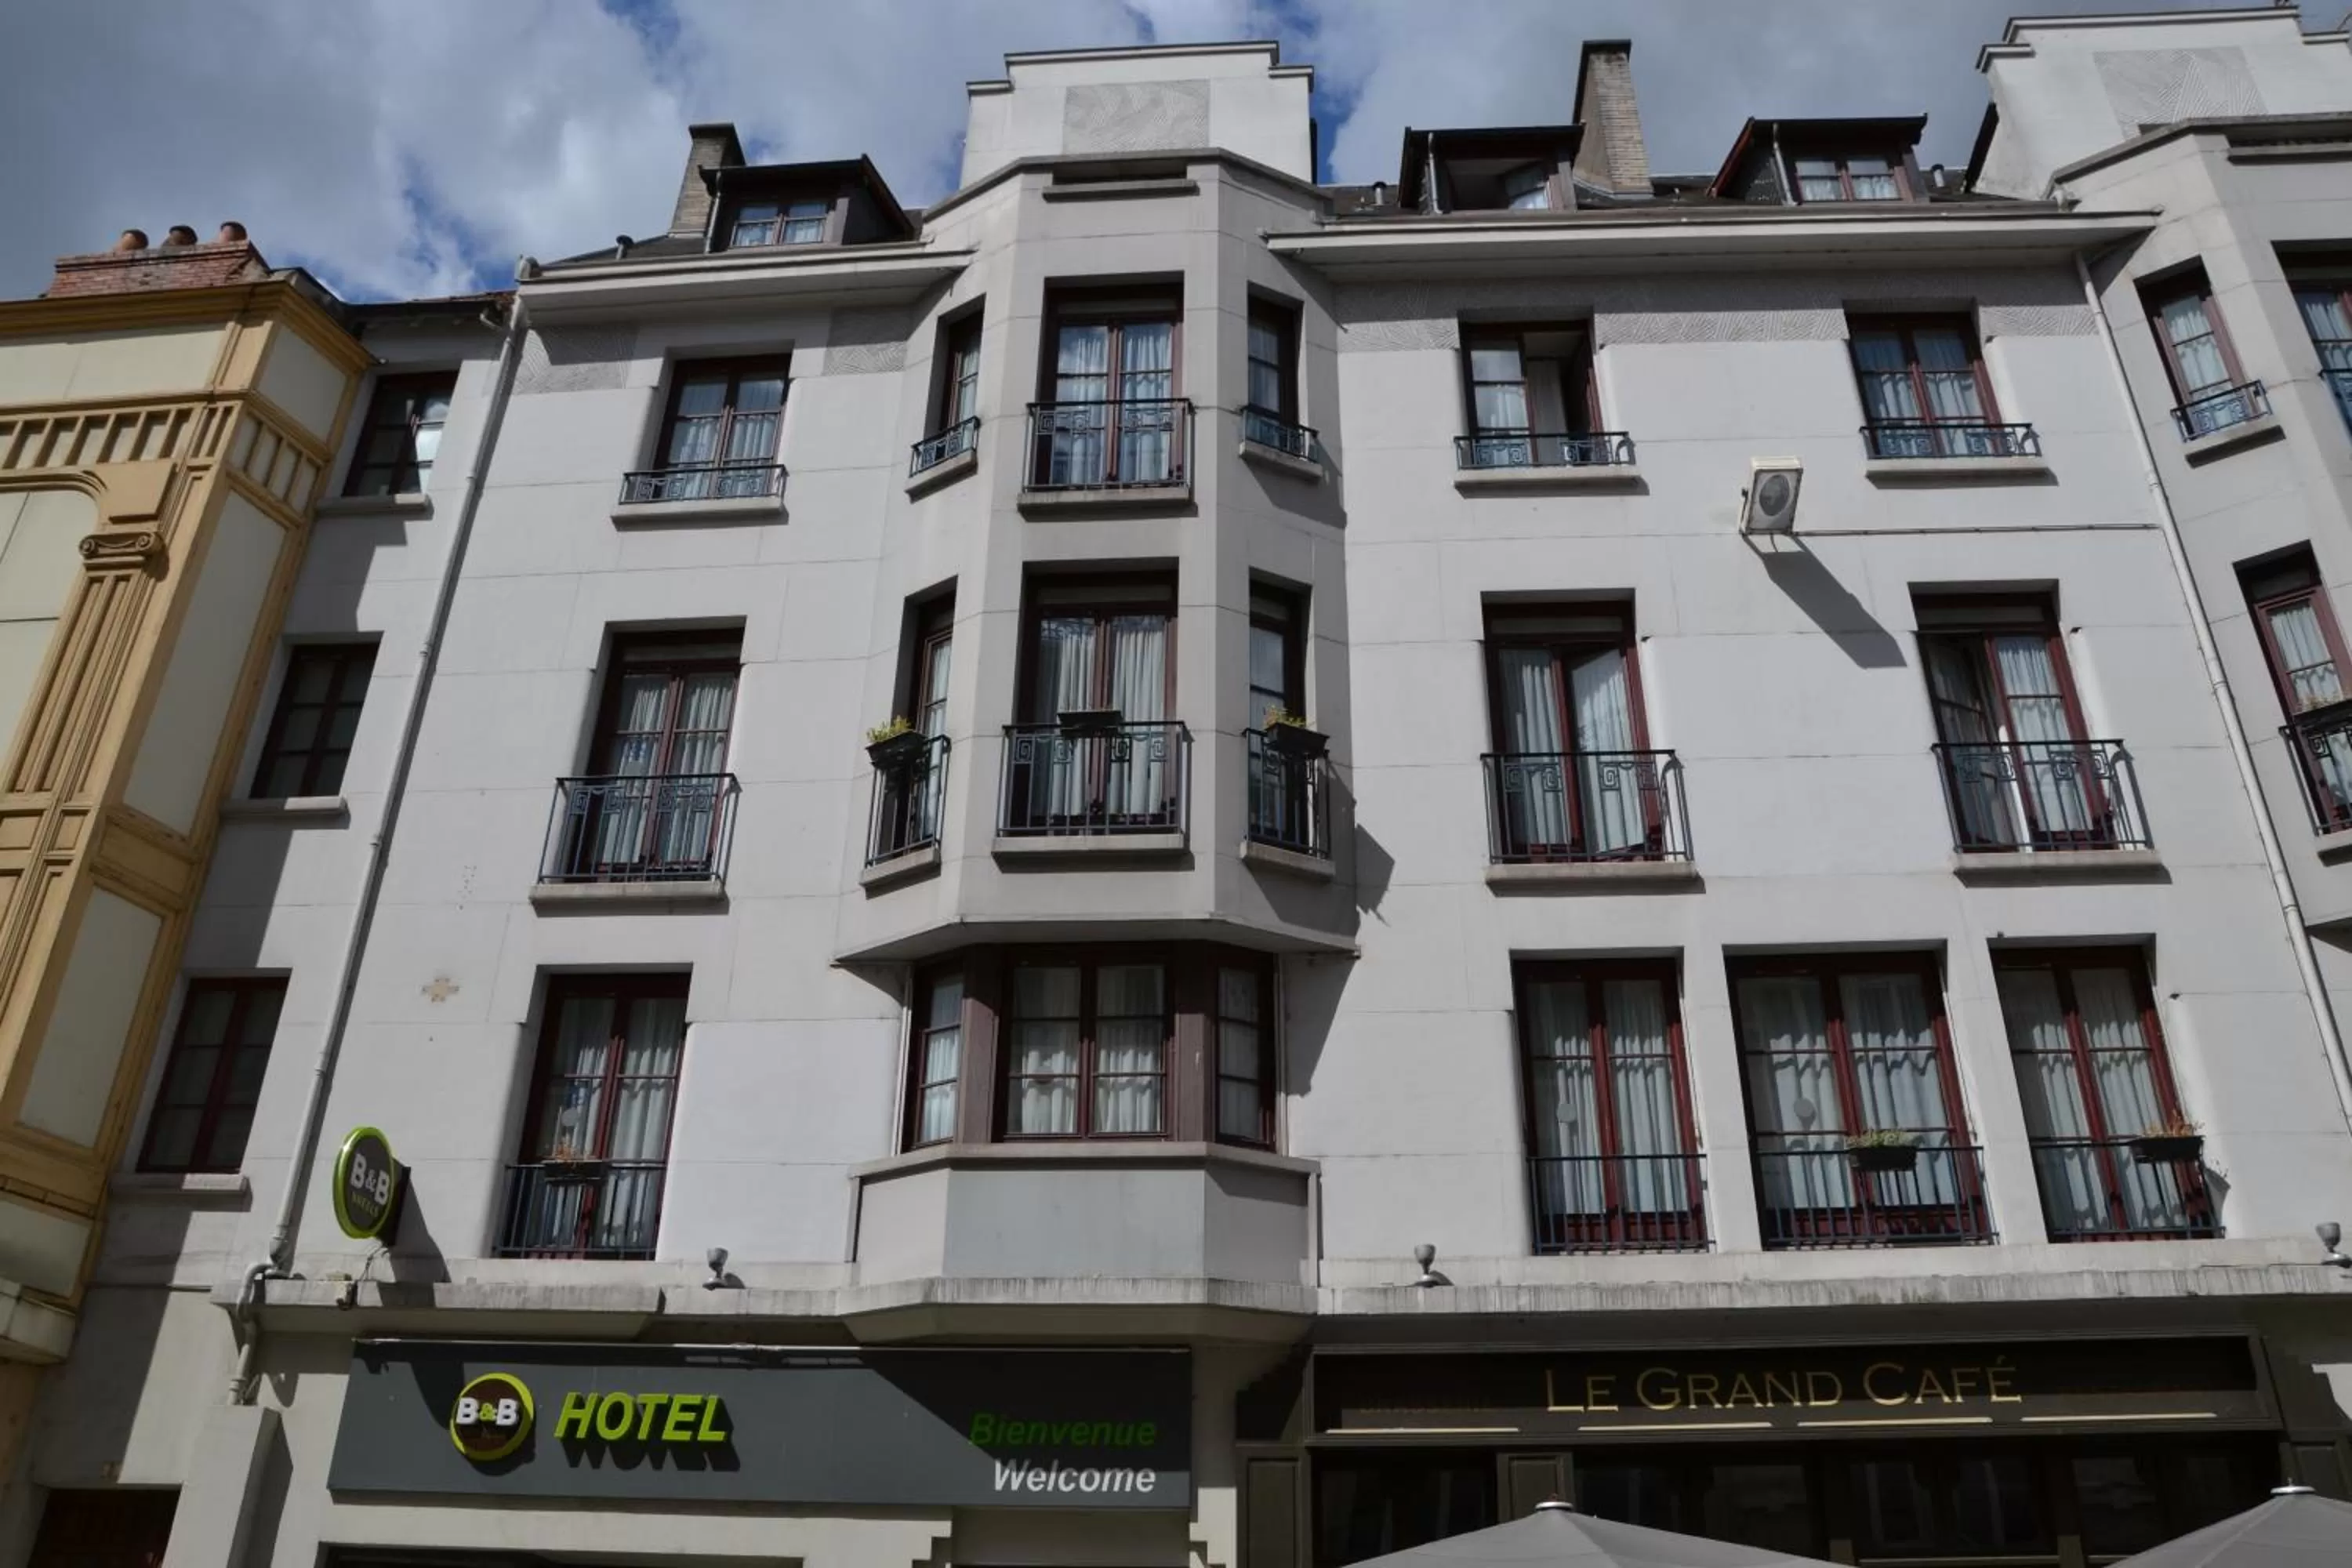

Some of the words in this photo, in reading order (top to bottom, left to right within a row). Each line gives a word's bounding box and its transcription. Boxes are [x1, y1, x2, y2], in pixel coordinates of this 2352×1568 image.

[350, 1152, 390, 1207] B&B
[1544, 1368, 1620, 1413] LE
[1636, 1366, 1842, 1411] GRAND
[1863, 1355, 2023, 1406] CAFÉ
[456, 1396, 520, 1426] B&B
[555, 1392, 727, 1443] HOTEL
[971, 1412, 1156, 1446] Bienvenue
[993, 1458, 1156, 1493] Welcome
